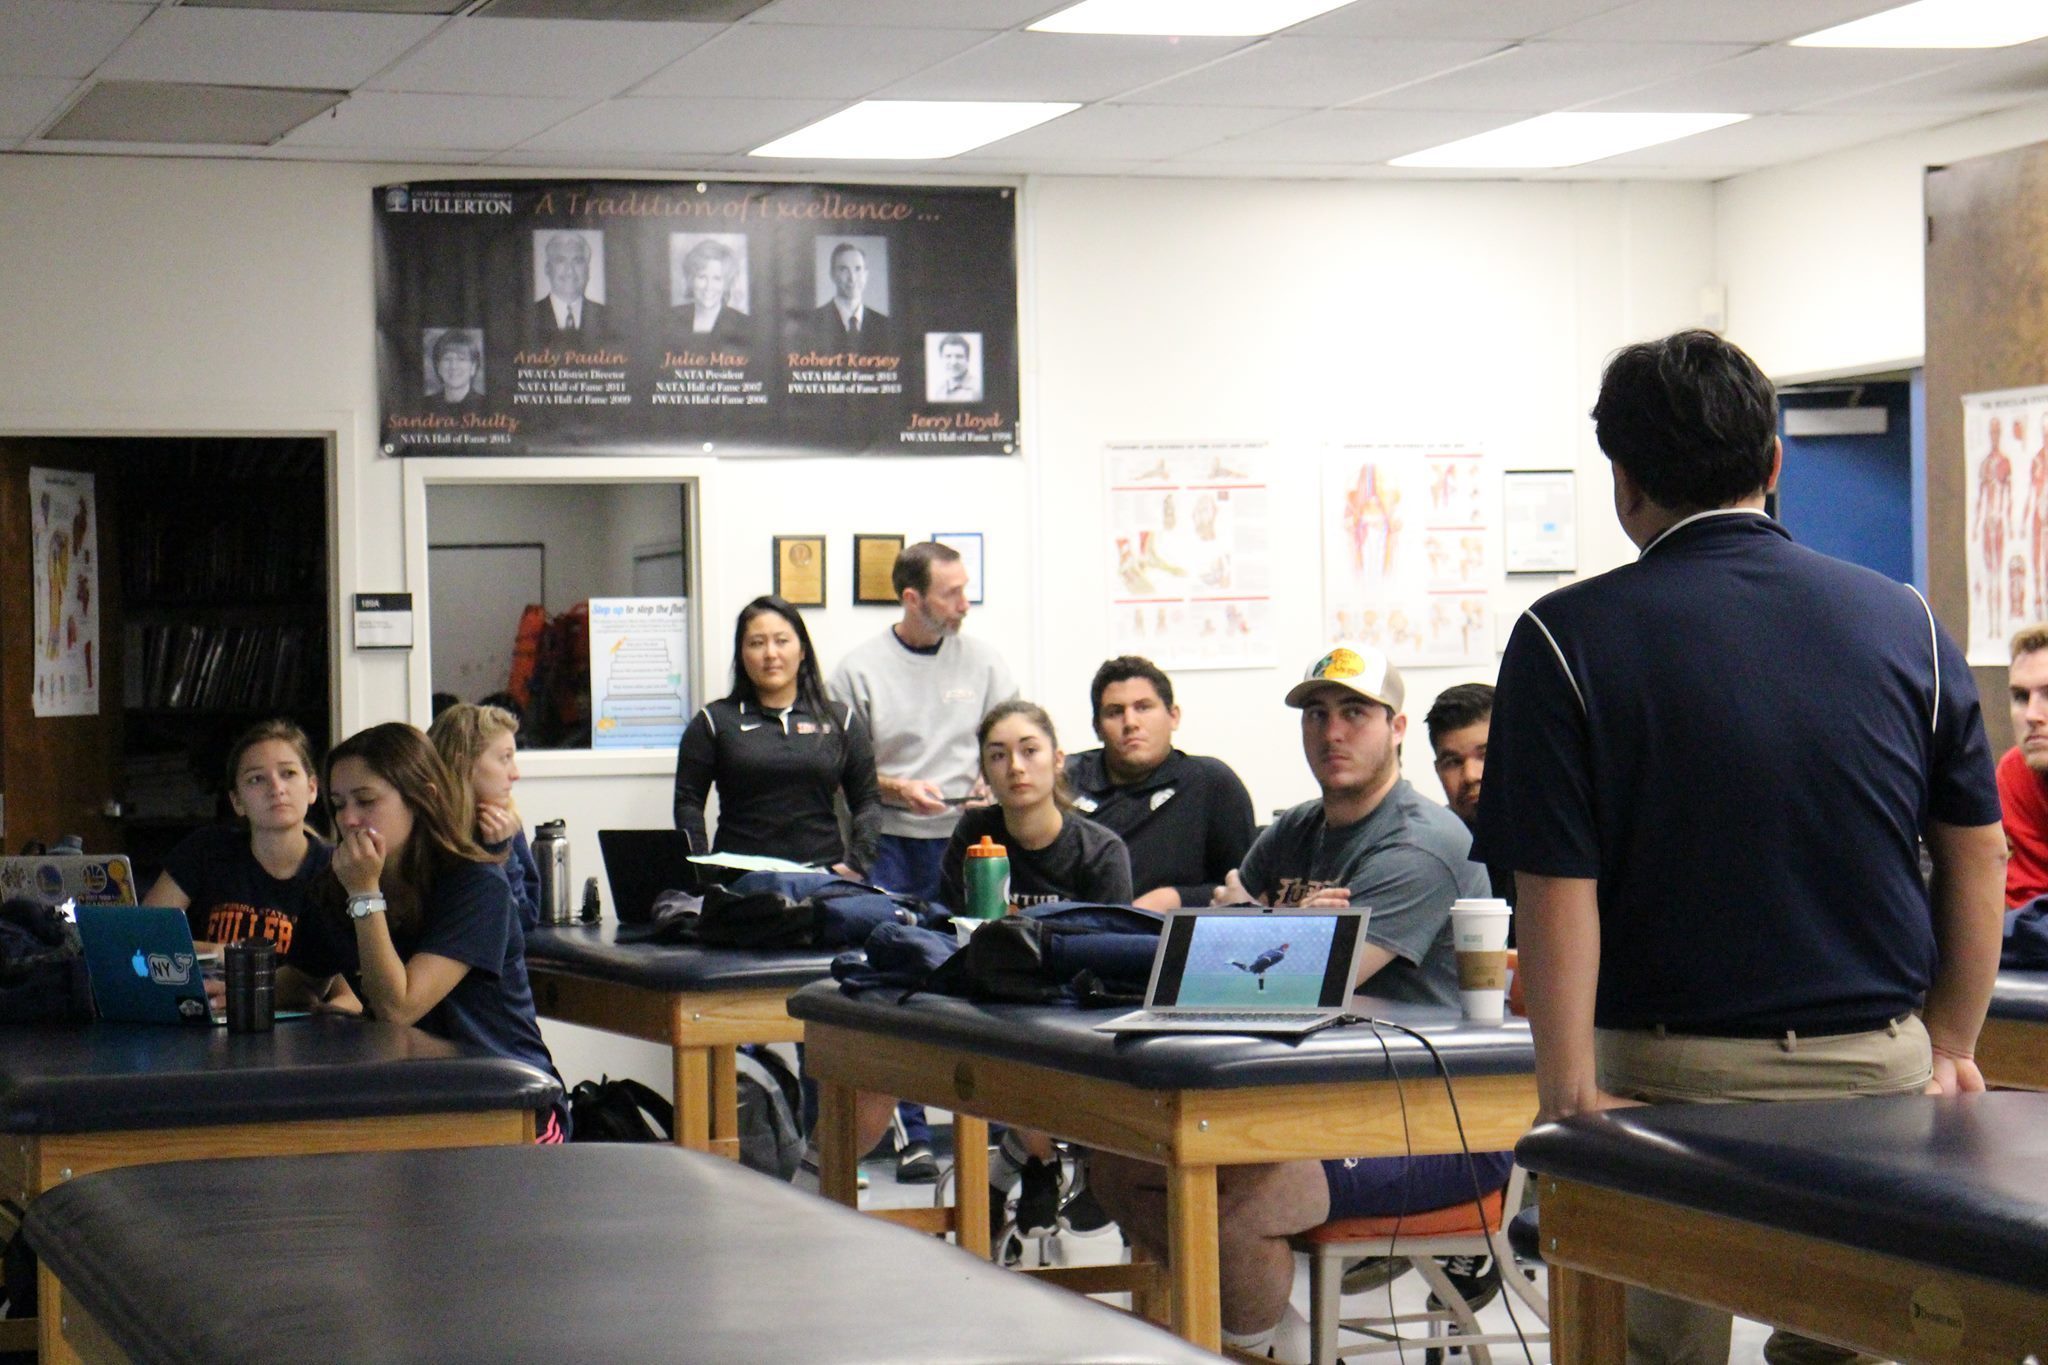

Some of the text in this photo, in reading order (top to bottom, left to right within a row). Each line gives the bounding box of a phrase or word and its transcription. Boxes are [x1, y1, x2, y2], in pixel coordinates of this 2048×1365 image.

[411, 199, 512, 214] FULLERTON
[535, 191, 555, 215] A
[568, 191, 717, 216] Tradition
[723, 193, 750, 224] of
[759, 192, 913, 220] Excellence
[513, 349, 628, 369] Andy Paulin
[661, 351, 749, 369] Julie Max
[788, 351, 900, 370] Robert Kersey
[558, 369, 588, 379] District
[591, 369, 625, 379] Director
[675, 369, 744, 379] NATA President
[792, 371, 821, 381] NATA
[822, 371, 841, 381] Hall
[852, 371, 875, 381] Fame
[549, 382, 567, 392] Hall
[580, 382, 603, 392] Fame
[656, 382, 686, 392] NATA
[687, 382, 706, 392] Hall
[717, 382, 740, 392] Fame
[827, 383, 845, 393] Hall
[846, 383, 856, 393] of
[857, 383, 879, 393] Fame
[554, 394, 572, 404] Hall
[585, 394, 607, 404] Fame
[691, 394, 710, 404] Hall
[722, 394, 744, 404] Fame
[388, 412, 459, 429] Sandra
[907, 412, 1003, 432] Jerry Lloyd
[432, 433, 451, 443] Hall
[453, 433, 462, 443] of
[464, 433, 487, 443] Fame
[938, 431, 956, 442] Hall
[592, 604, 611, 616] Step
[626, 605, 634, 614] to
[637, 605, 654, 616] stop
[656, 604, 668, 614] the
[152, 961, 170, 977] NY
